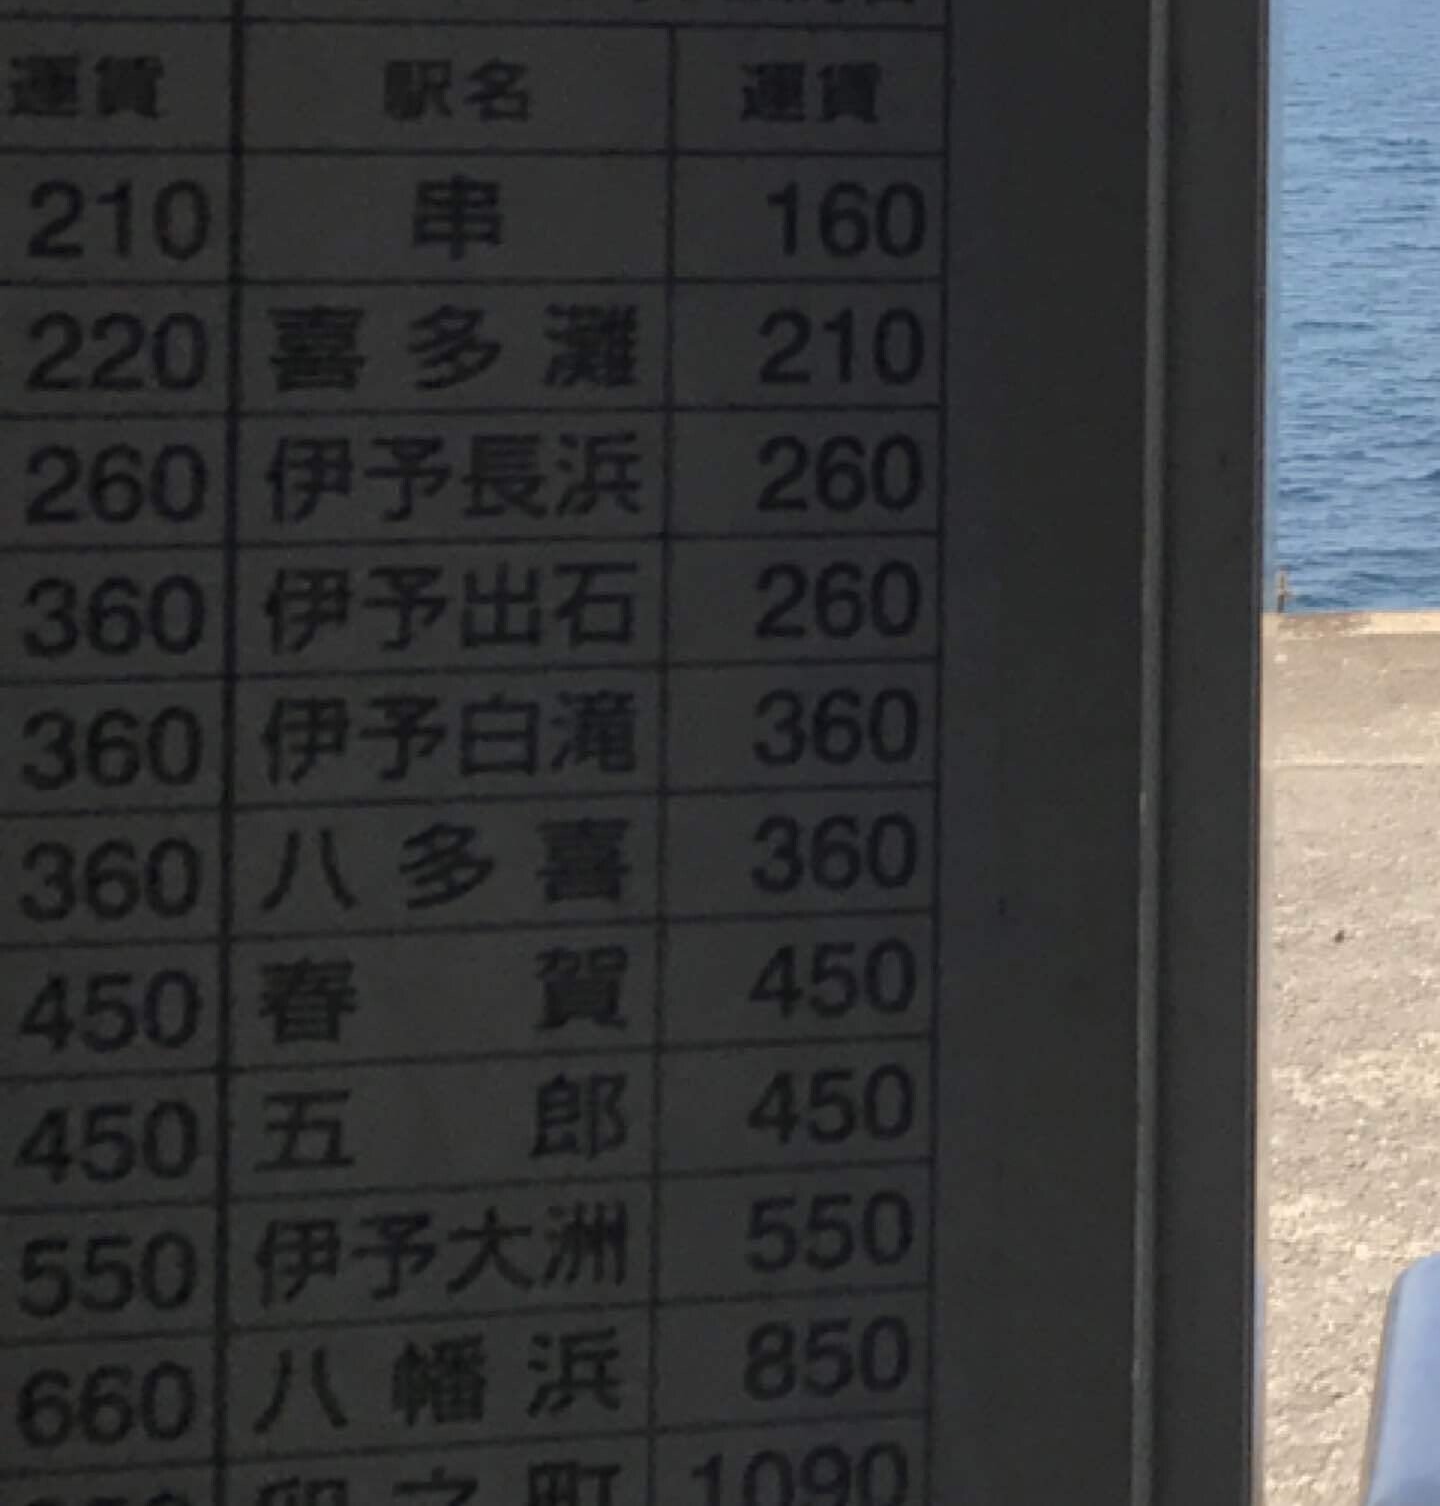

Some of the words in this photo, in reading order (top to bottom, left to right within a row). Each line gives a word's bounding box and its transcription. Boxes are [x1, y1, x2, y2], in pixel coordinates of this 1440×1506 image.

[8, 54, 164, 120] 運賃
[384, 58, 530, 122] 駅名
[741, 61, 882, 124] 運賃
[28, 179, 212, 261] 210
[412, 176, 502, 260] 串
[767, 180, 927, 259] 160
[25, 311, 208, 392] 220
[759, 307, 925, 386] 210
[25, 443, 208, 525] 260
[264, 430, 642, 524] 伊予長浜
[757, 432, 924, 513] 260
[23, 574, 206, 659] 360
[262, 562, 638, 654] 伊予出石
[755, 559, 922, 639] 260
[22, 706, 203, 791] 360
[260, 689, 636, 785] 伊予白滝
[753, 687, 921, 766] 360
[19, 837, 201, 923] 360
[751, 811, 919, 894] 360
[19, 969, 203, 1053] 450
[749, 936, 917, 1019] 450
[15, 1100, 199, 1184] 450
[747, 1063, 915, 1145] 450
[254, 1201, 629, 1310] 伊予大洲
[748, 1190, 914, 1273] 550
[19, 1231, 197, 1319] 550
[744, 1315, 912, 1401] 850
[15, 1361, 196, 1448] 660
[692, 1442, 910, 1506] 1090
